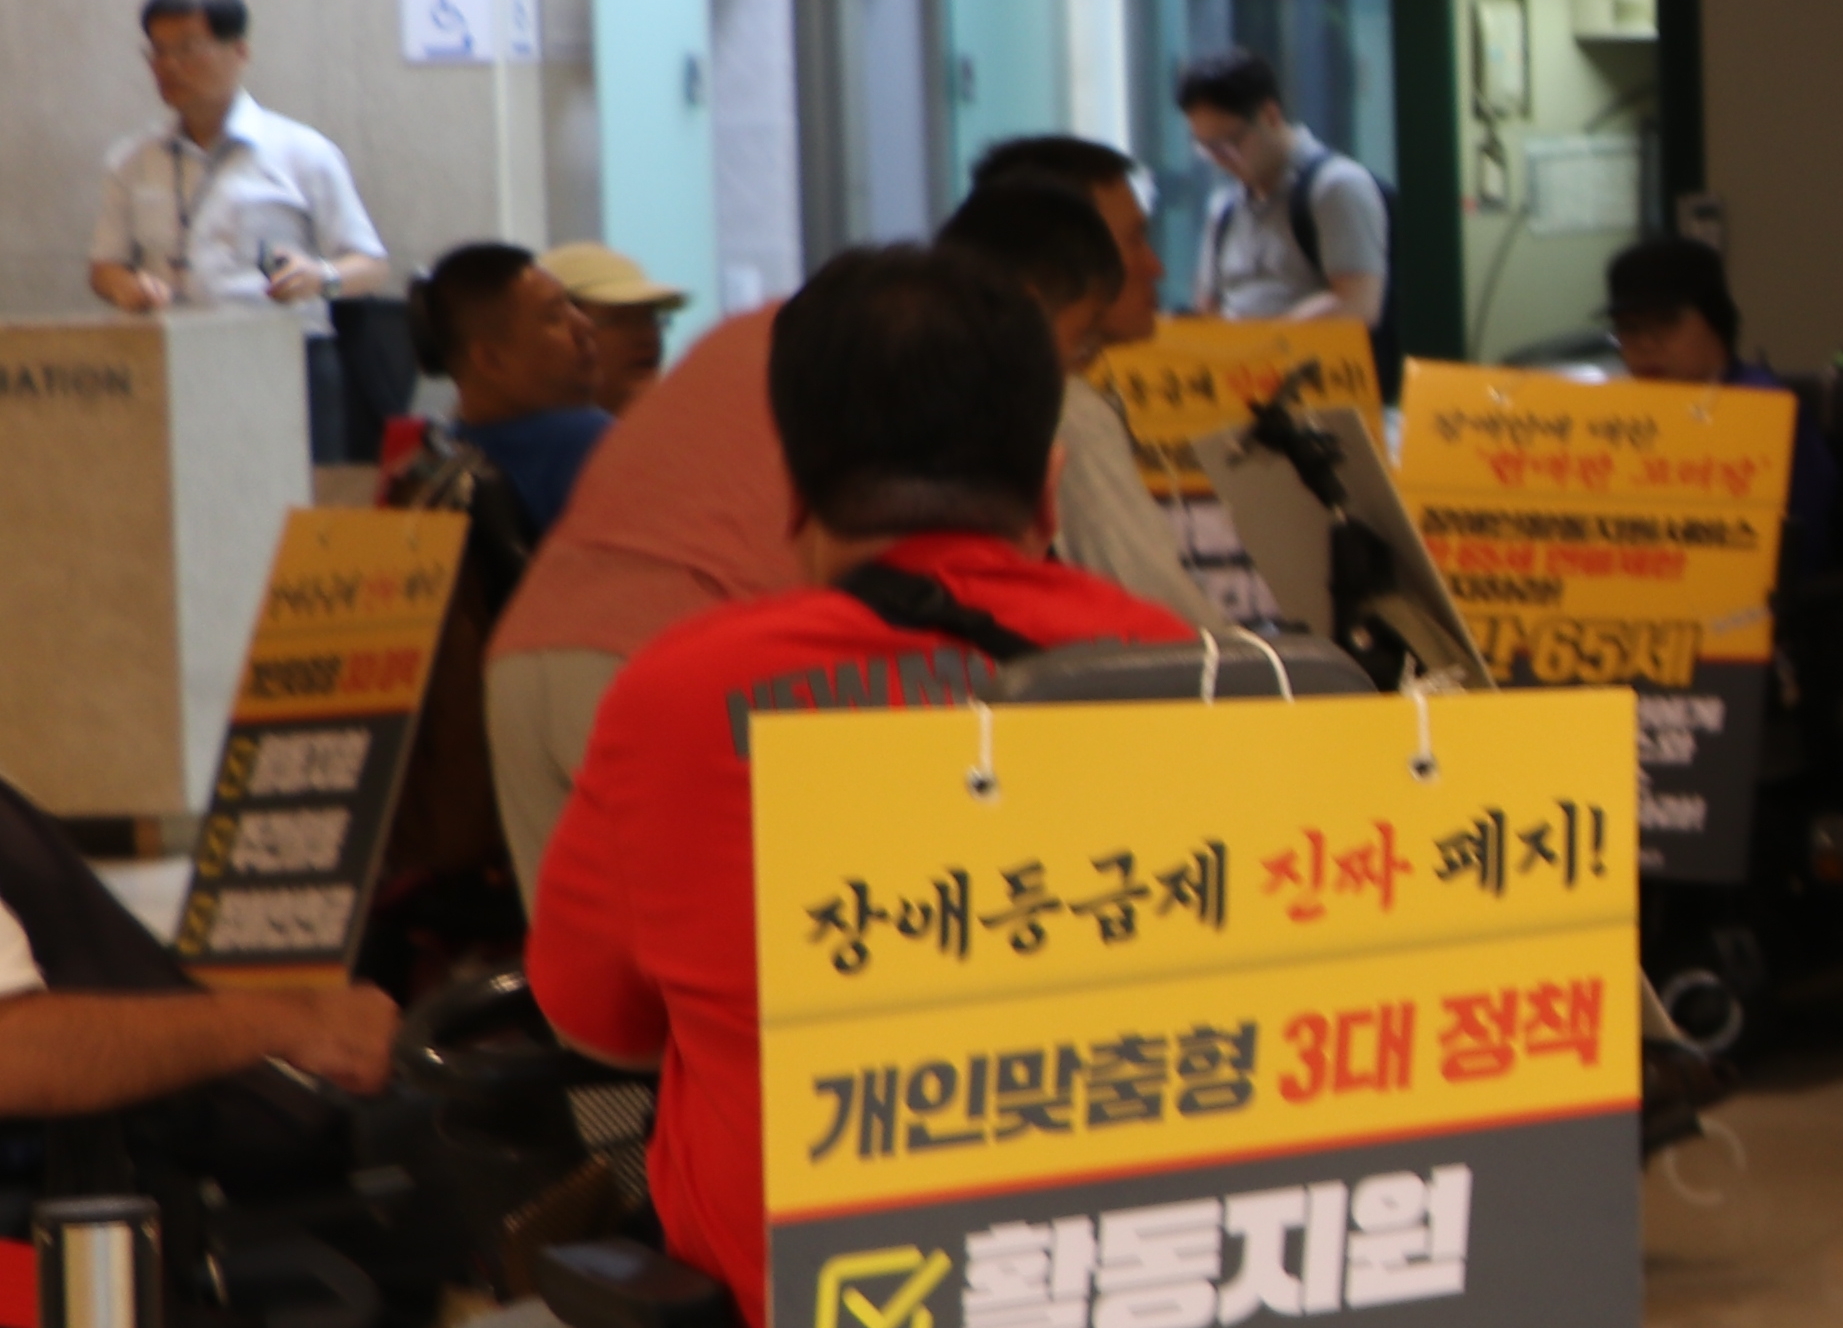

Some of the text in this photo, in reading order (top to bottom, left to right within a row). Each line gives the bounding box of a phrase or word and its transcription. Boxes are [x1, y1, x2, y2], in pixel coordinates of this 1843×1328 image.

[811, 799, 1610, 975] 장애등급제 진짜 폐지!
[811, 980, 1606, 1162] 개인맞춤형 3대 정책
